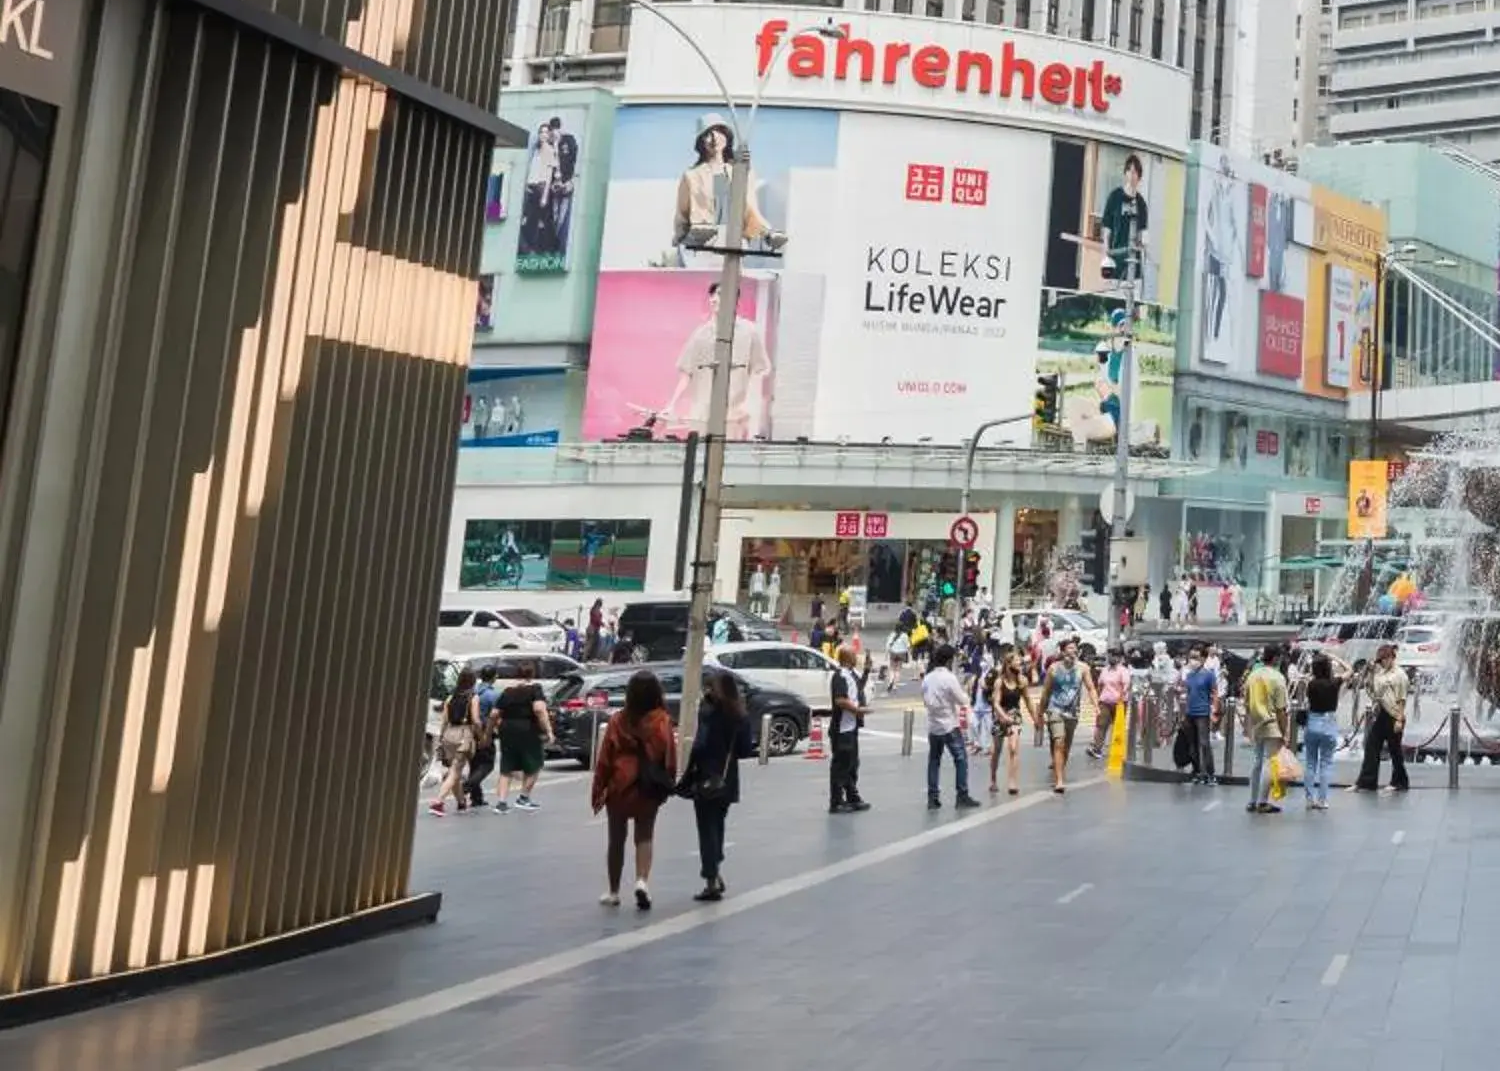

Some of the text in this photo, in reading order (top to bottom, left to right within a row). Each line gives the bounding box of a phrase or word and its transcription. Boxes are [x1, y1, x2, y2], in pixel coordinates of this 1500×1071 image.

[755, 18, 1110, 113] fahrenheit
[867, 246, 1012, 281] KOLEKSI
[864, 280, 1007, 319] LifeWear
